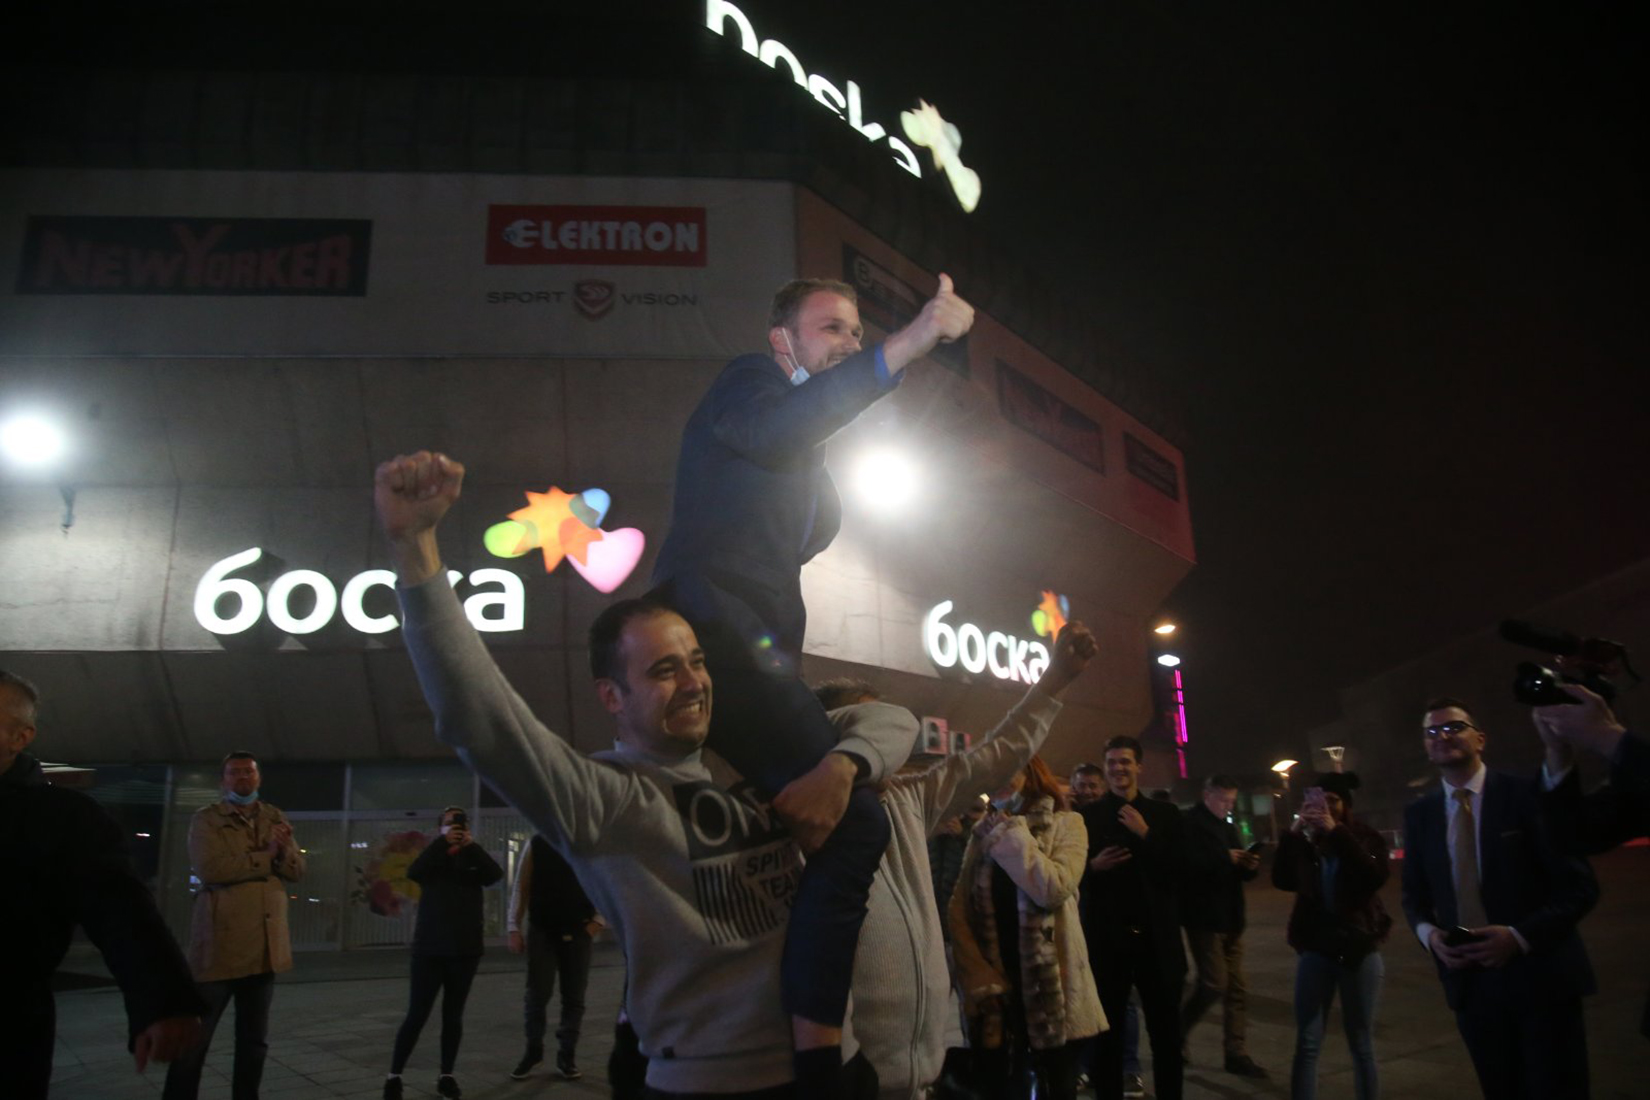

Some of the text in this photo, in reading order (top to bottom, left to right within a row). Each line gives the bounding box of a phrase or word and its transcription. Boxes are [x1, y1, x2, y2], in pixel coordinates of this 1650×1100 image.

[503, 218, 699, 252] ELEKTRON
[487, 291, 698, 306] SPORT VISION
